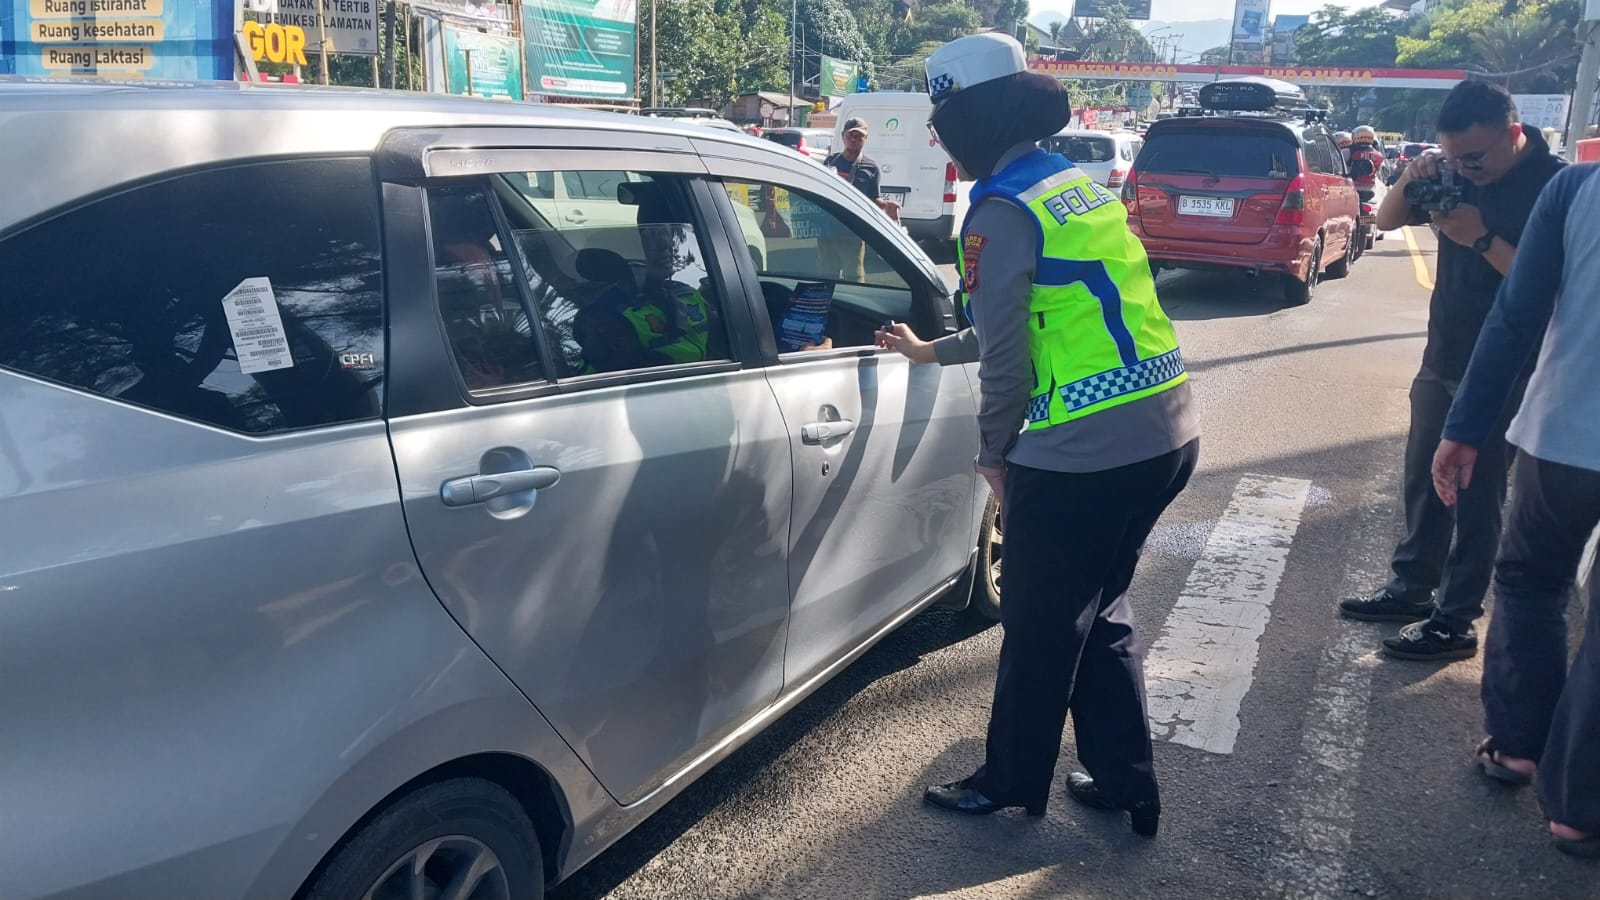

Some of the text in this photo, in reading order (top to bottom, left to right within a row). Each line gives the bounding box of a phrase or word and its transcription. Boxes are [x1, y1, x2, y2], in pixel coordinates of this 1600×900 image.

[45, 0, 86, 15] Ruang
[280, 0, 370, 13] DAYAKN TERTIB
[39, 22, 155, 41] Ruang kesehatan
[243, 20, 307, 65] GOR
[49, 48, 144, 67] Ruang Laktasi
[1119, 65, 1177, 78] BOGOR
[1263, 69, 1372, 82] INDONESIA
[1042, 181, 1115, 226] POLIS
[1182, 198, 1231, 211] B 1535 KKL
[342, 353, 374, 365] CPF1
